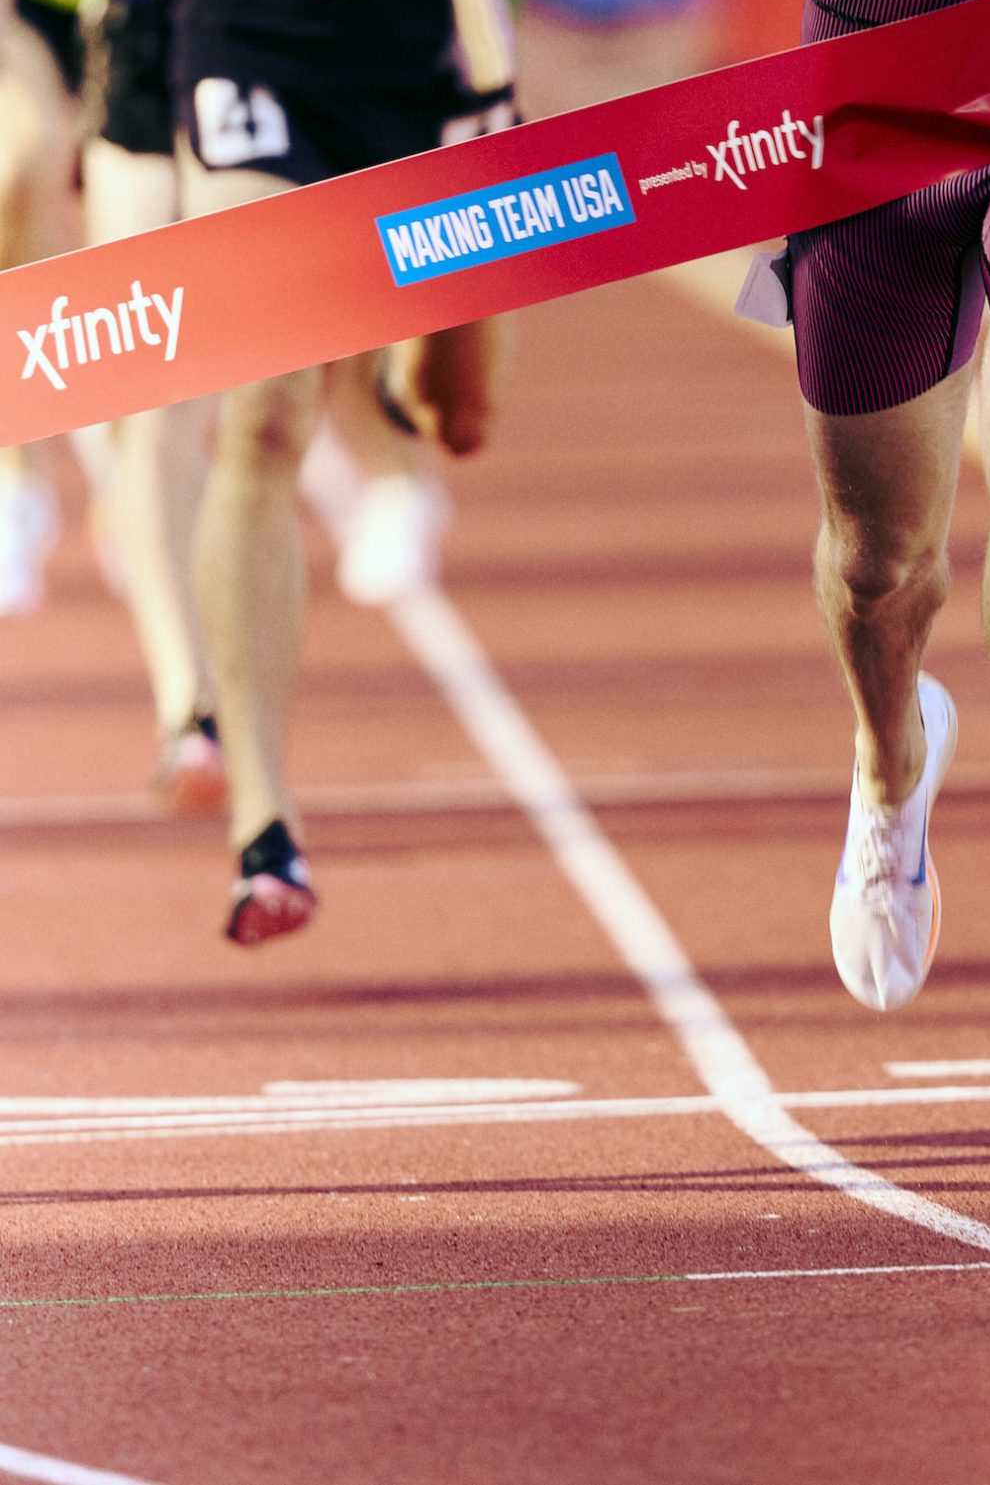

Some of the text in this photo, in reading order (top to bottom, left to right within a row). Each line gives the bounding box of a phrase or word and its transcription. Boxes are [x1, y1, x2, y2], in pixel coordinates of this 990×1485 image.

[638, 160, 708, 196] presented by
[705, 109, 825, 191] xfinity
[386, 168, 625, 273] MAKING TEAM USA
[16, 279, 185, 391] xfinity
